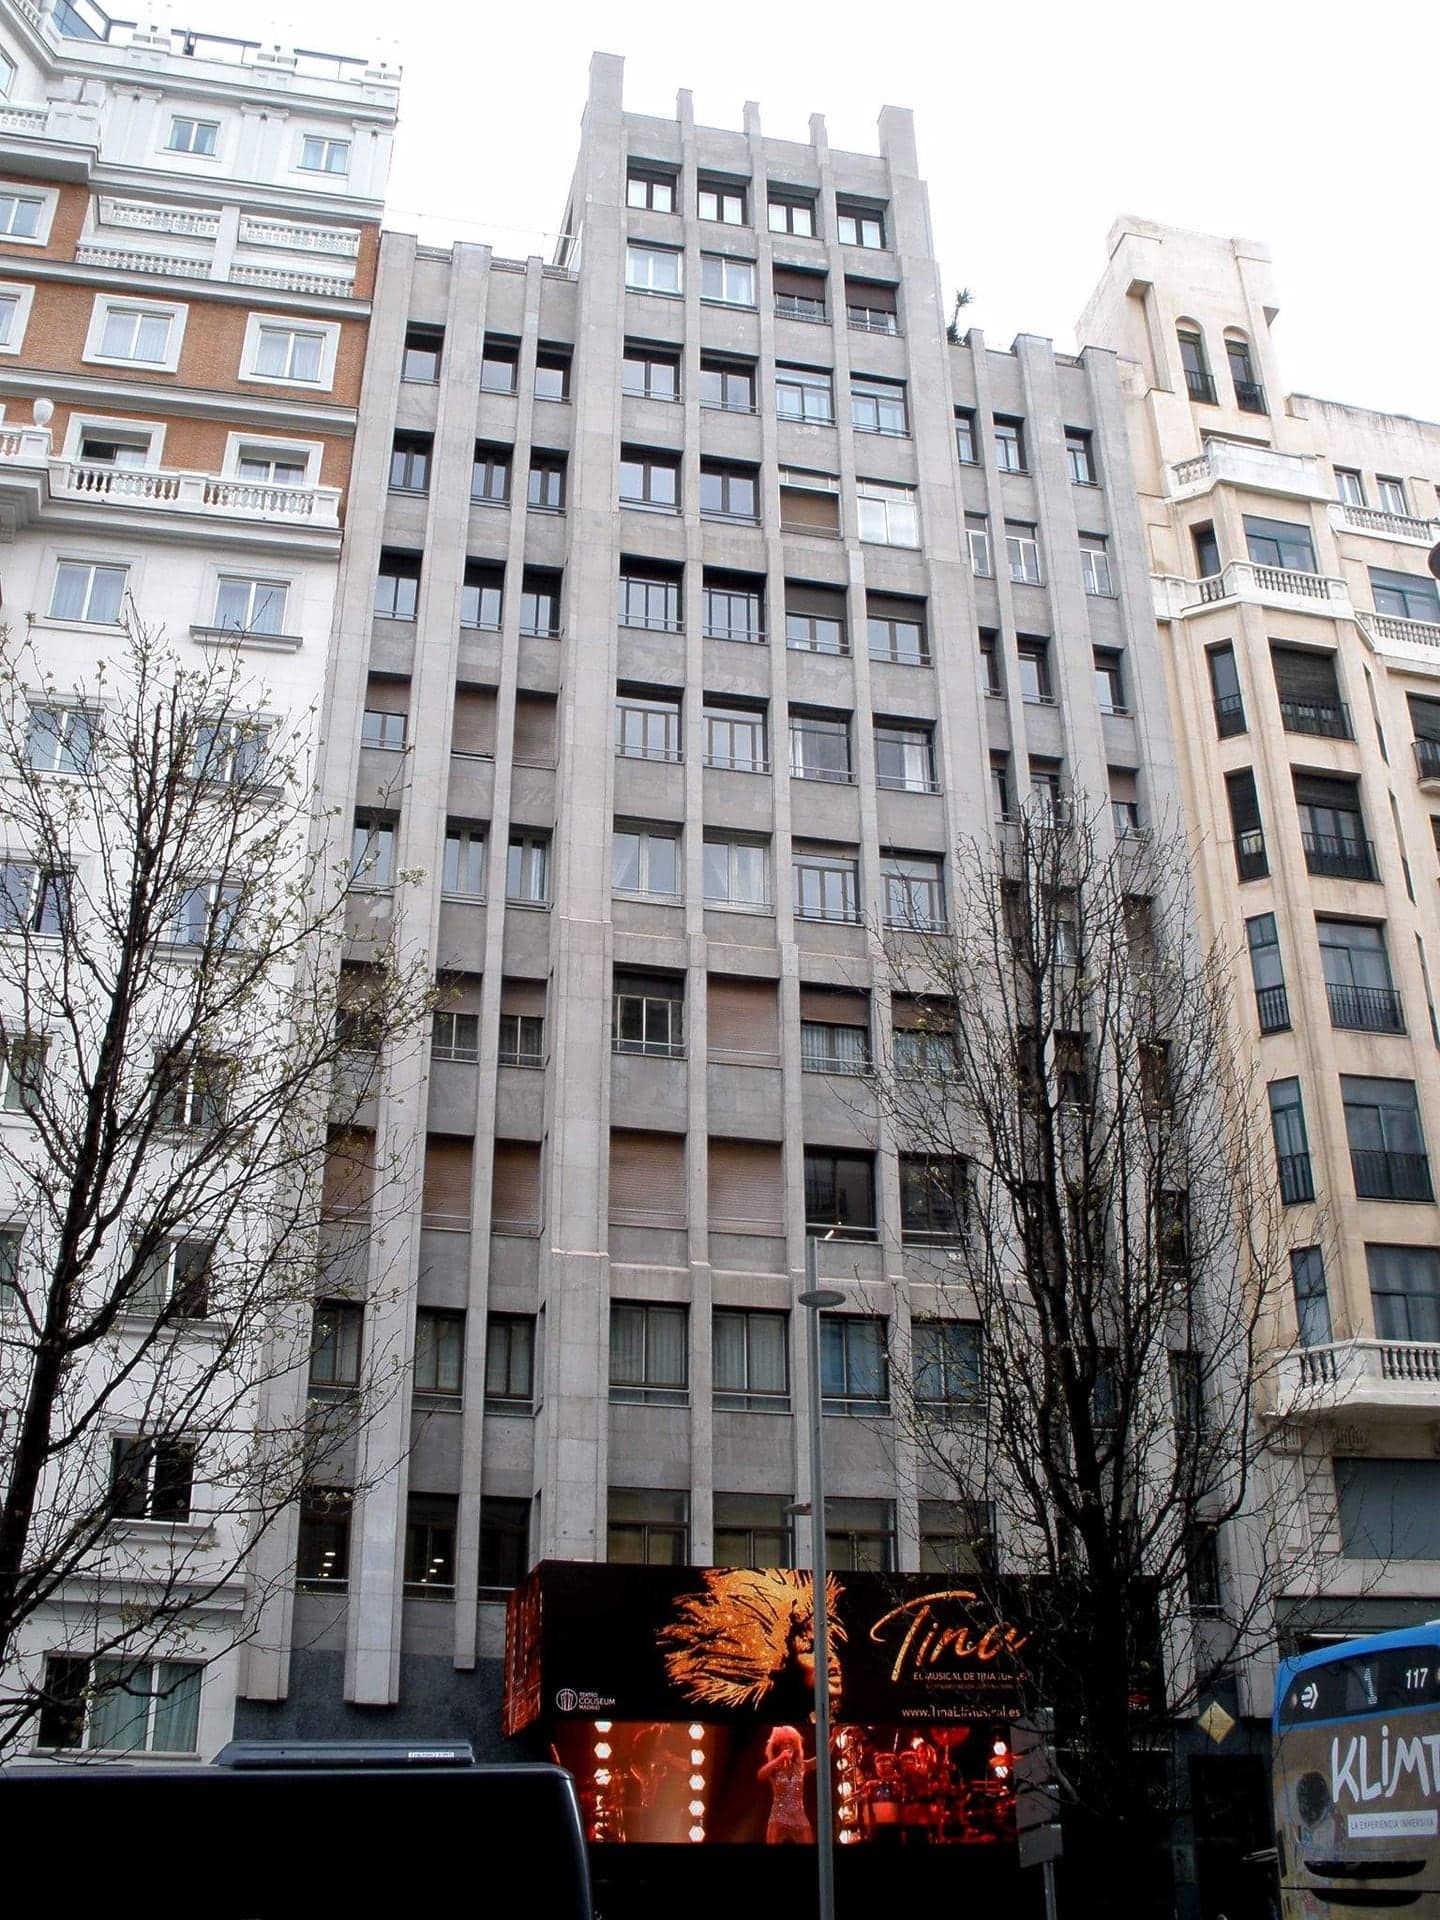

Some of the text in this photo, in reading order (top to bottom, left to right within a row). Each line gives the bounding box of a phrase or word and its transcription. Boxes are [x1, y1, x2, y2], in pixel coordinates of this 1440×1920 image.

[868, 1589, 1033, 1683] Tina
[913, 1672, 924, 1681] EL
[925, 1672, 961, 1681] MUSICAL
[963, 1672, 975, 1681] DE
[977, 1672, 997, 1681] TINA
[1405, 1667, 1429, 1689] 117
[578, 1697, 616, 1705] COLISEUM
[1359, 1819, 1398, 1830] EXPERIENCIA
